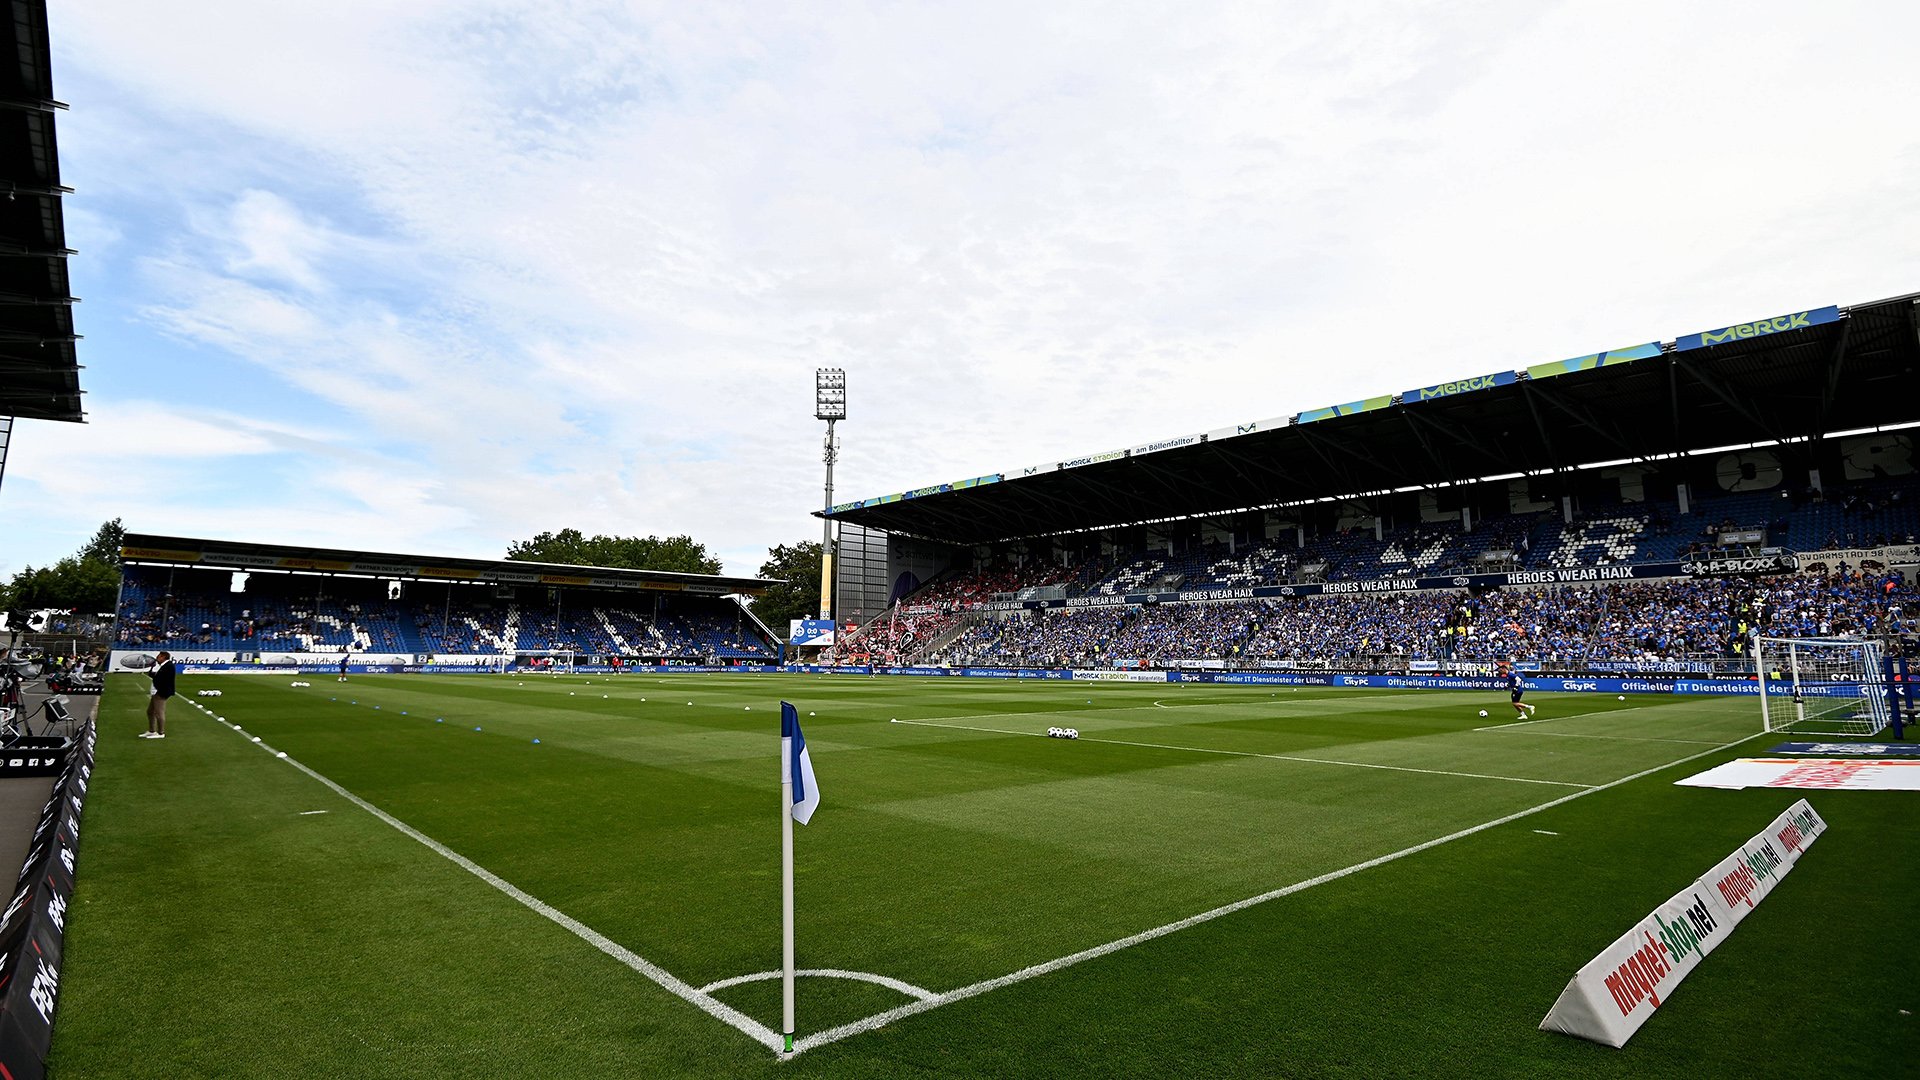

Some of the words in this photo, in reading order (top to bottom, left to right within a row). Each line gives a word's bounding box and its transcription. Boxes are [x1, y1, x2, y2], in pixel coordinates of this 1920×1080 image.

[1701, 312, 1810, 346] MERCK
[1420, 374, 1495, 400] MERCK
[1148, 436, 1194, 452] Böllenfalltor
[912, 484, 942, 497] MERCK
[1710, 556, 1776, 572] A-BLOXX
[1508, 571, 1555, 584] HEROES
[1558, 568, 1598, 582] WEAR
[1600, 566, 1634, 580] HAIX
[1179, 592, 1208, 601] HEROES
[1209, 590, 1233, 600] WEAR
[1234, 588, 1254, 598] HAIX
[1322, 583, 1358, 594] HEROES
[1360, 581, 1390, 592] WEAR
[1392, 580, 1418, 590] HAIX
[1066, 598, 1090, 606] HEROES
[1090, 597, 1109, 606] WEAR
[1110, 596, 1126, 604] HAIX
[1181, 674, 1200, 682] CityPC
[1343, 676, 1368, 686] CityPC
[1439, 680, 1492, 688] Dienstleister
[1494, 681, 1508, 689] der
[1561, 681, 1596, 690] CityPC
[1622, 683, 1674, 692] Offizieller
[1676, 684, 1688, 692] IT
[1692, 684, 1761, 692] Dienstleiste
[1769, 685, 1791, 693] der
[1716, 838, 1782, 909] magnet-shop.net
[1604, 894, 1718, 1017] magnet-shop.net
